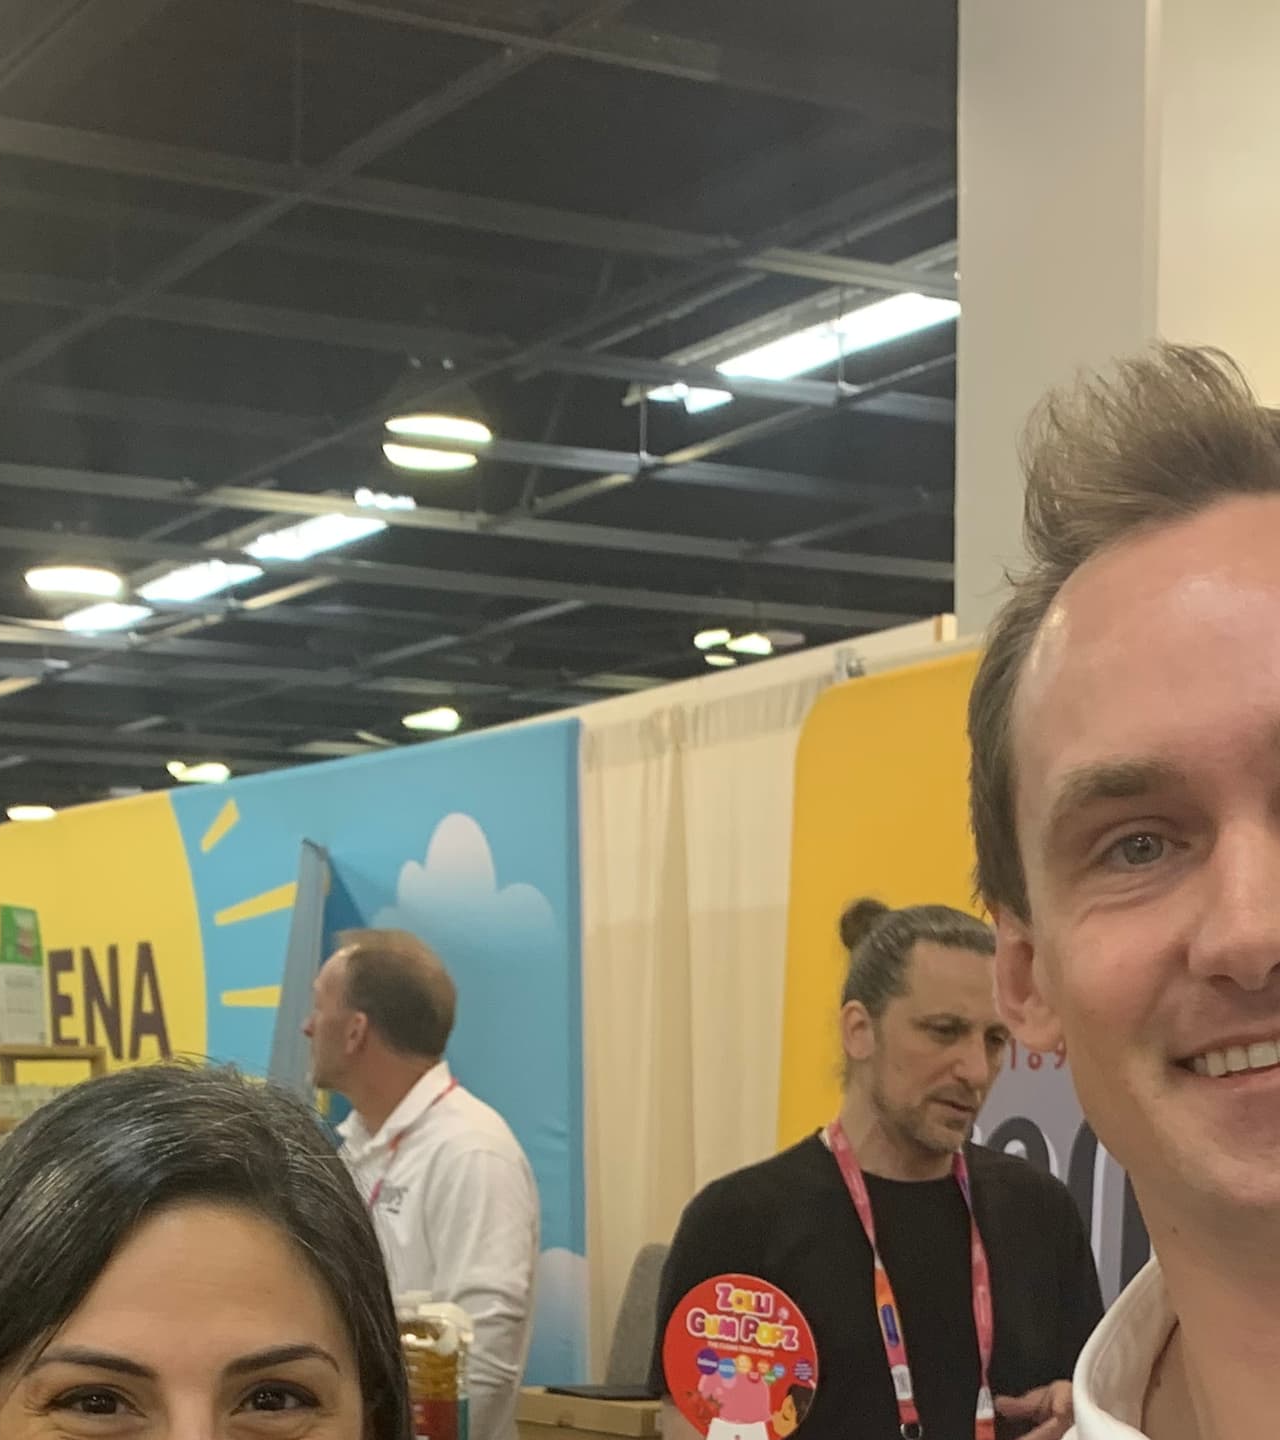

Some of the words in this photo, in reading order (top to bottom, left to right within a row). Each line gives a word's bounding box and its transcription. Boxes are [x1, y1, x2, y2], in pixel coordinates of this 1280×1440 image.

[48, 941, 174, 1060] ENA
[716, 1283, 774, 1317] ZOLLI
[686, 1307, 739, 1342] GUM
[741, 1315, 799, 1350] POPZ
